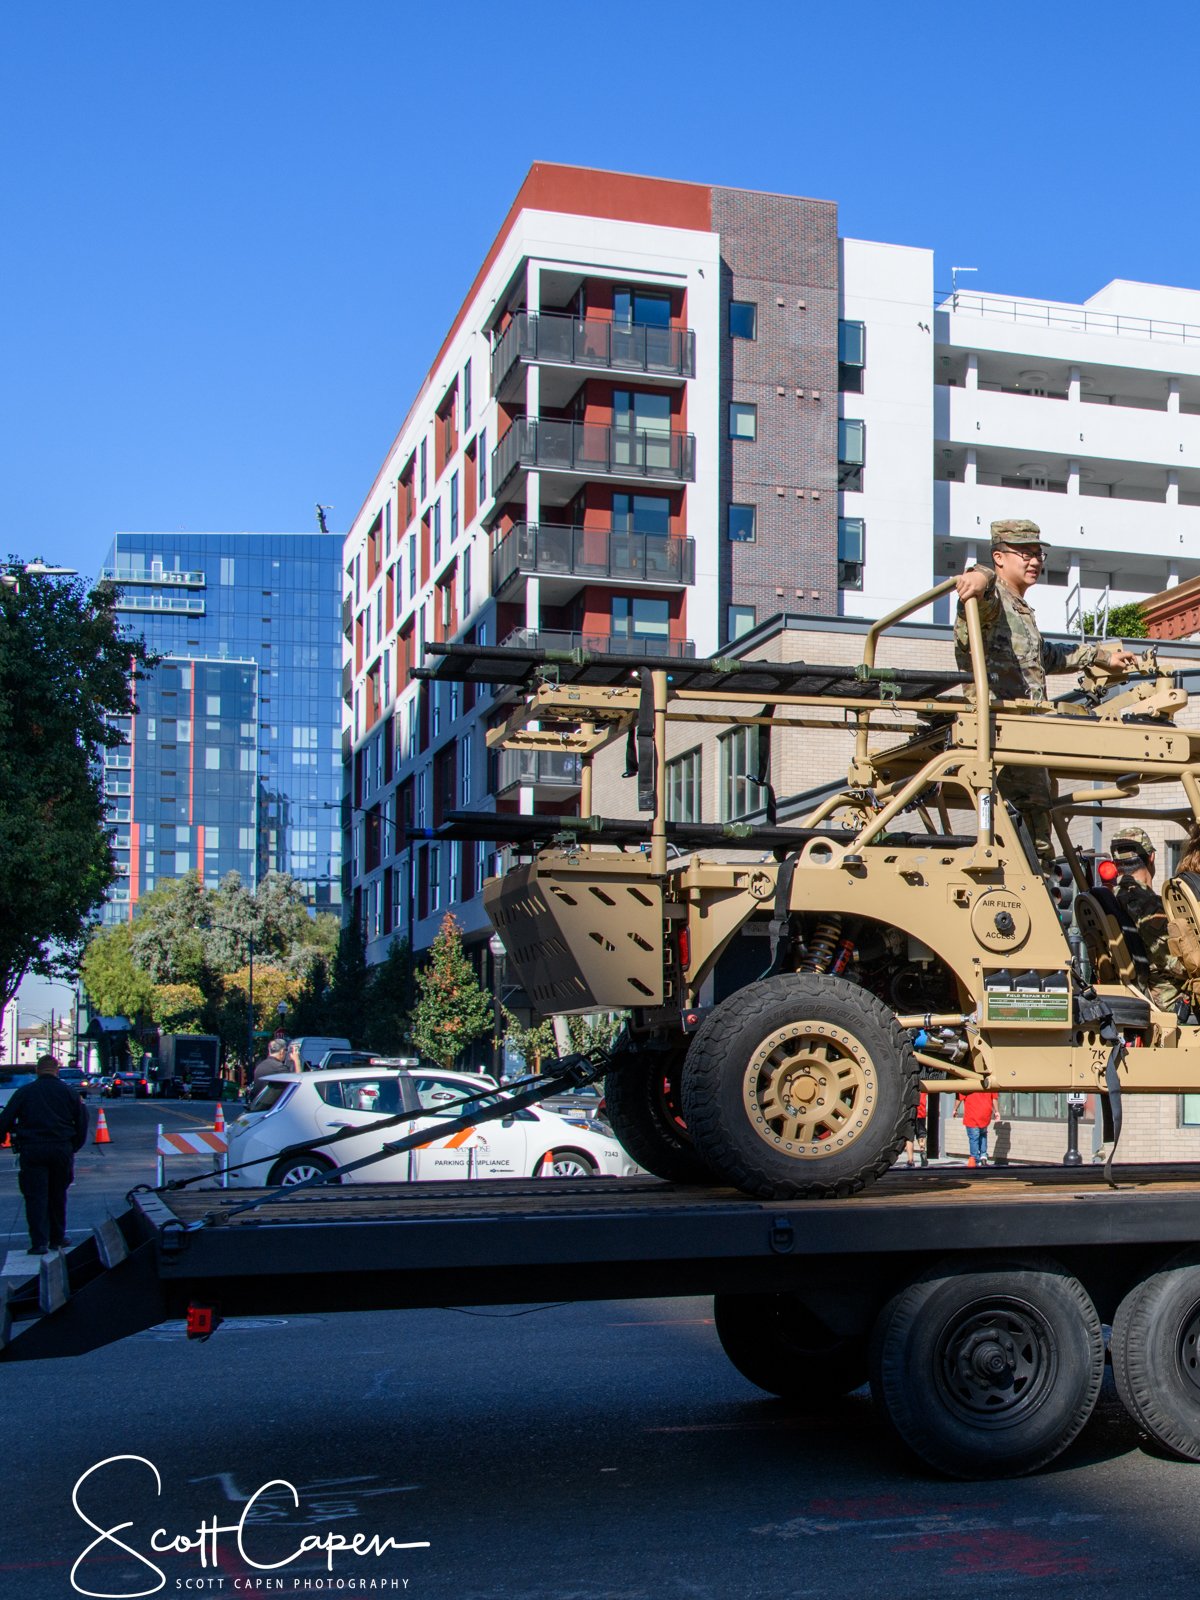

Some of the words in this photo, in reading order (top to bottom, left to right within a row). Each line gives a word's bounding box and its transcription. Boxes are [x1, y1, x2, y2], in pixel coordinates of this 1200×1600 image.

[996, 900, 1022, 909] FILTER
[985, 931, 1016, 940] ACCESS
[1092, 1050, 1106, 1060] 7K
[604, 1150, 619, 1158] 7343
